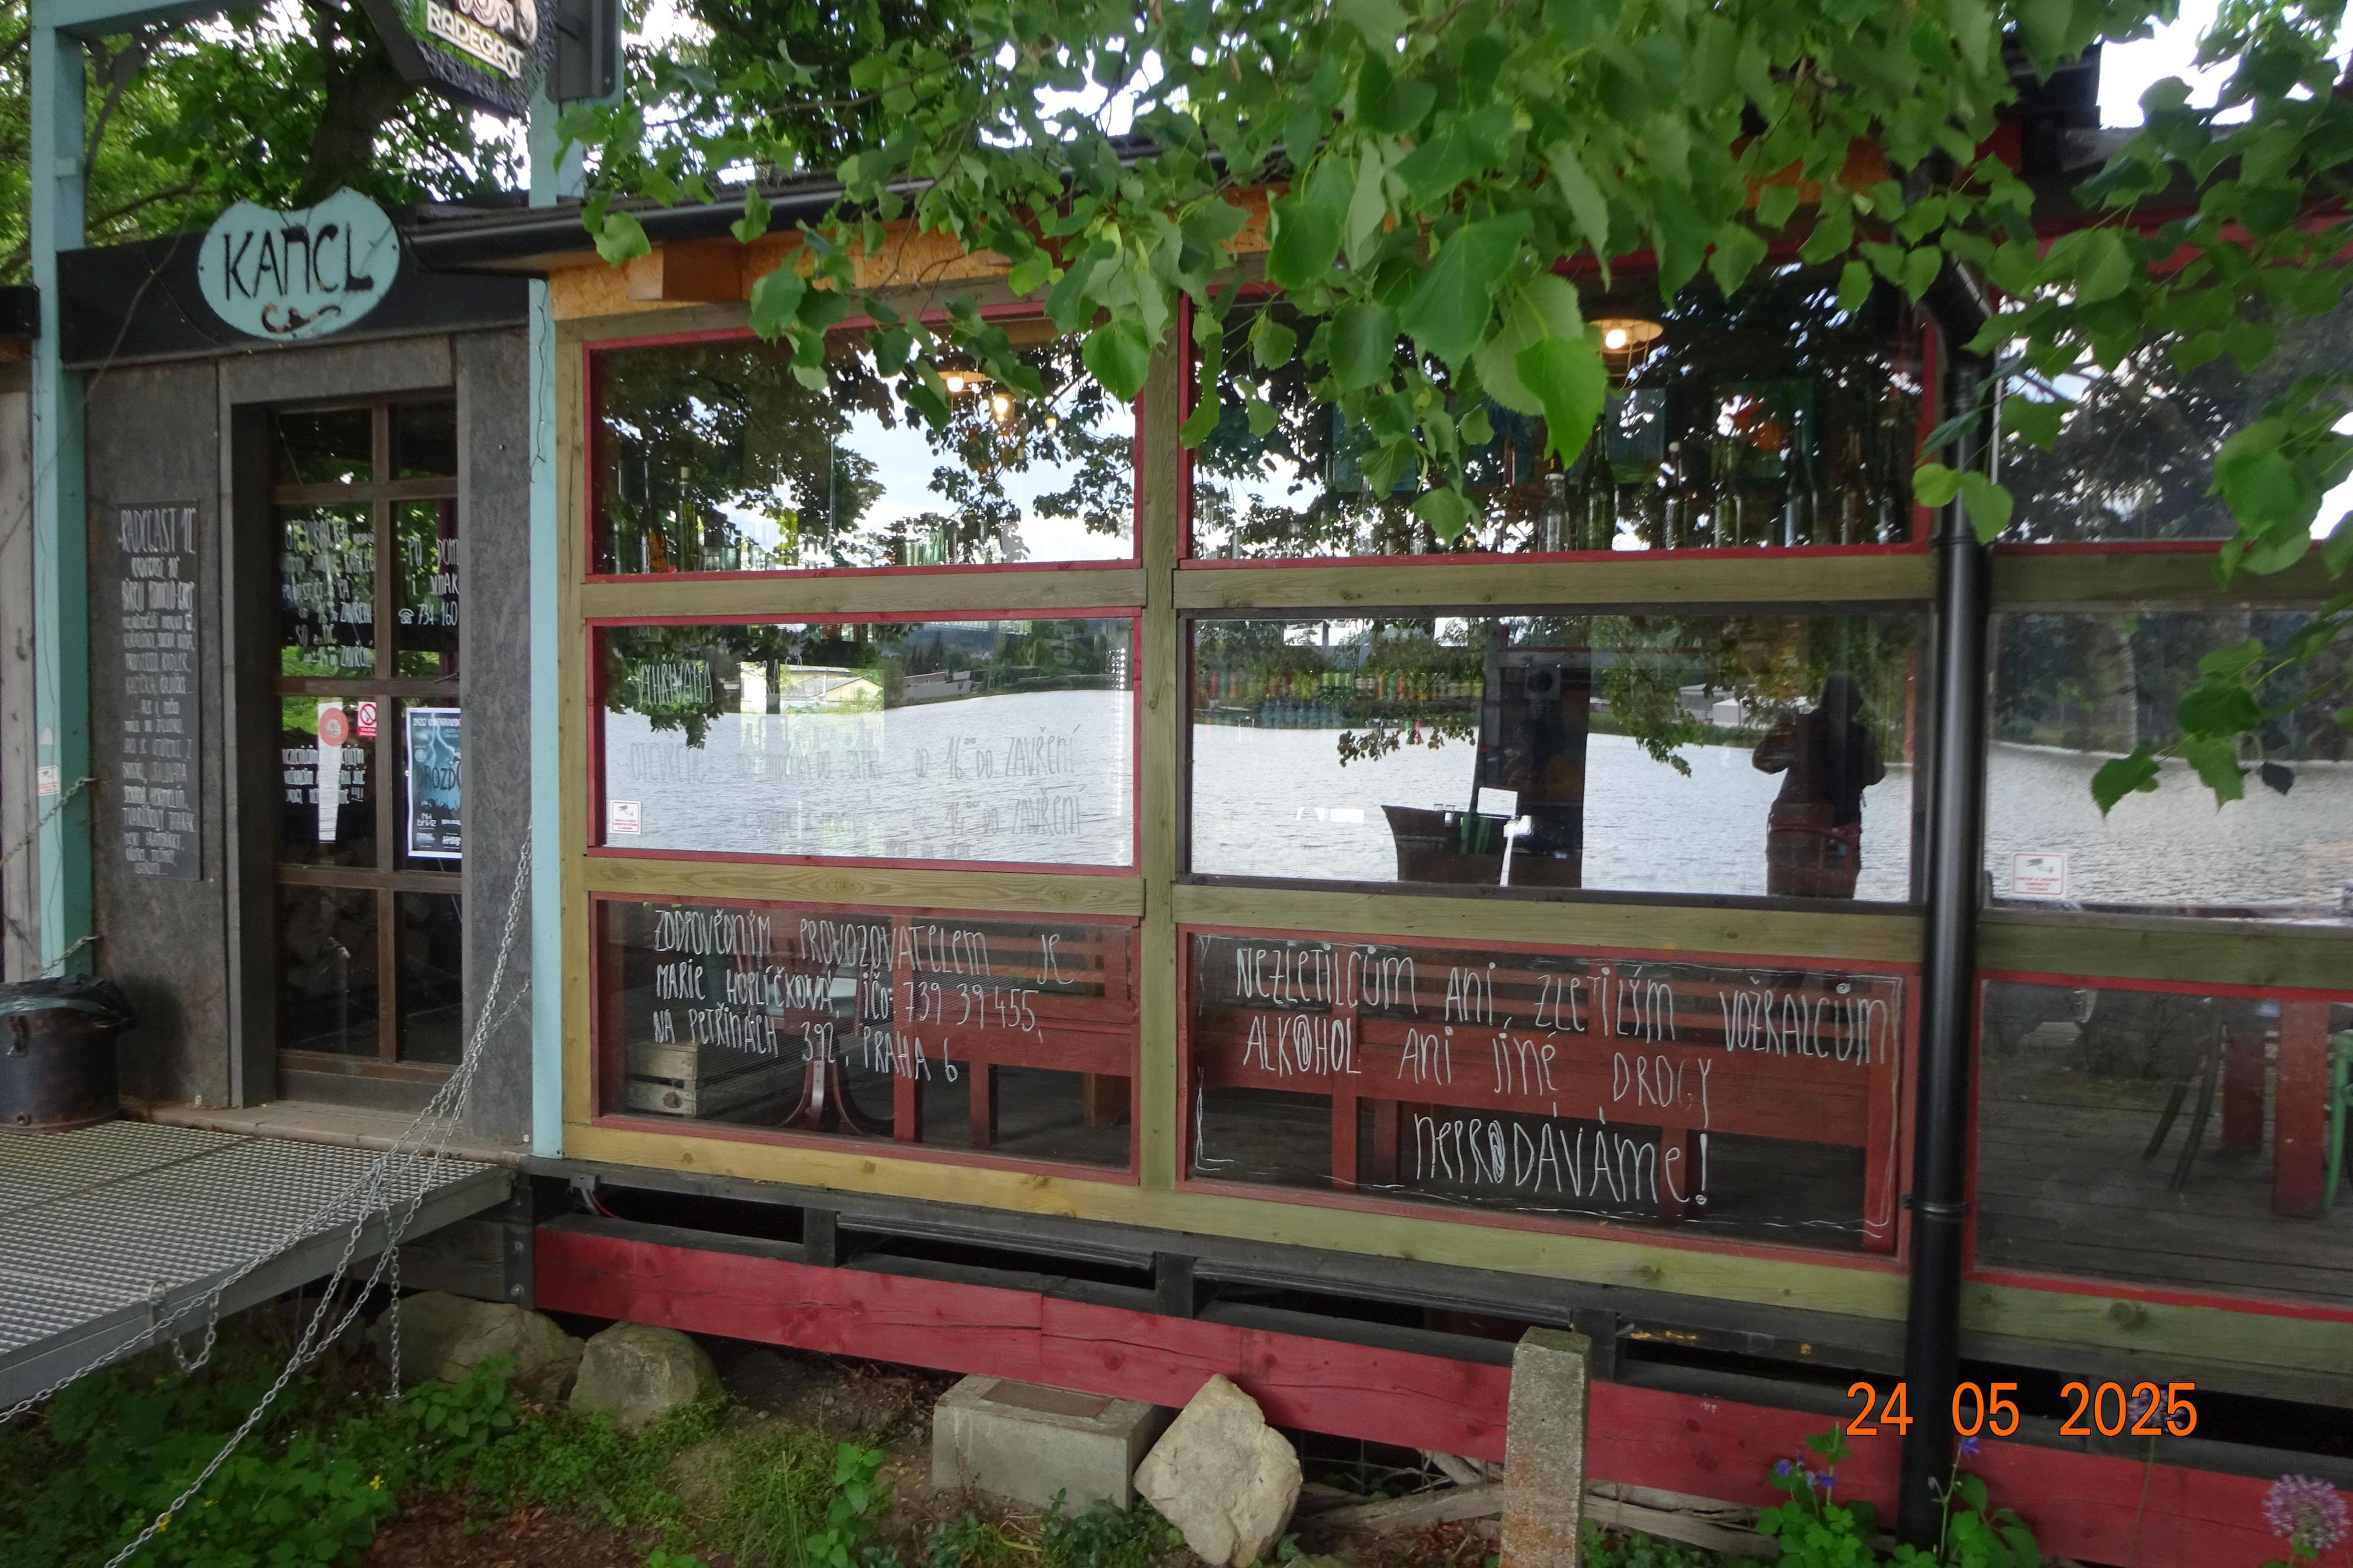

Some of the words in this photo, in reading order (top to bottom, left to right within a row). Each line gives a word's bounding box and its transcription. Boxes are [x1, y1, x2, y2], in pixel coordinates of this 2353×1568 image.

[427, 0, 525, 79] RADEGAST
[223, 222, 374, 301] KANCL
[441, 600, 458, 626] 160
[903, 982, 941, 1025] 739
[956, 983, 985, 1030] 39
[653, 1009, 676, 1044] NA
[864, 1026, 932, 1081] PRAHA
[944, 1037, 959, 1082] 6
[1242, 1014, 1362, 1077] ALKOHOL
[1614, 1052, 1712, 1129] DROGY
